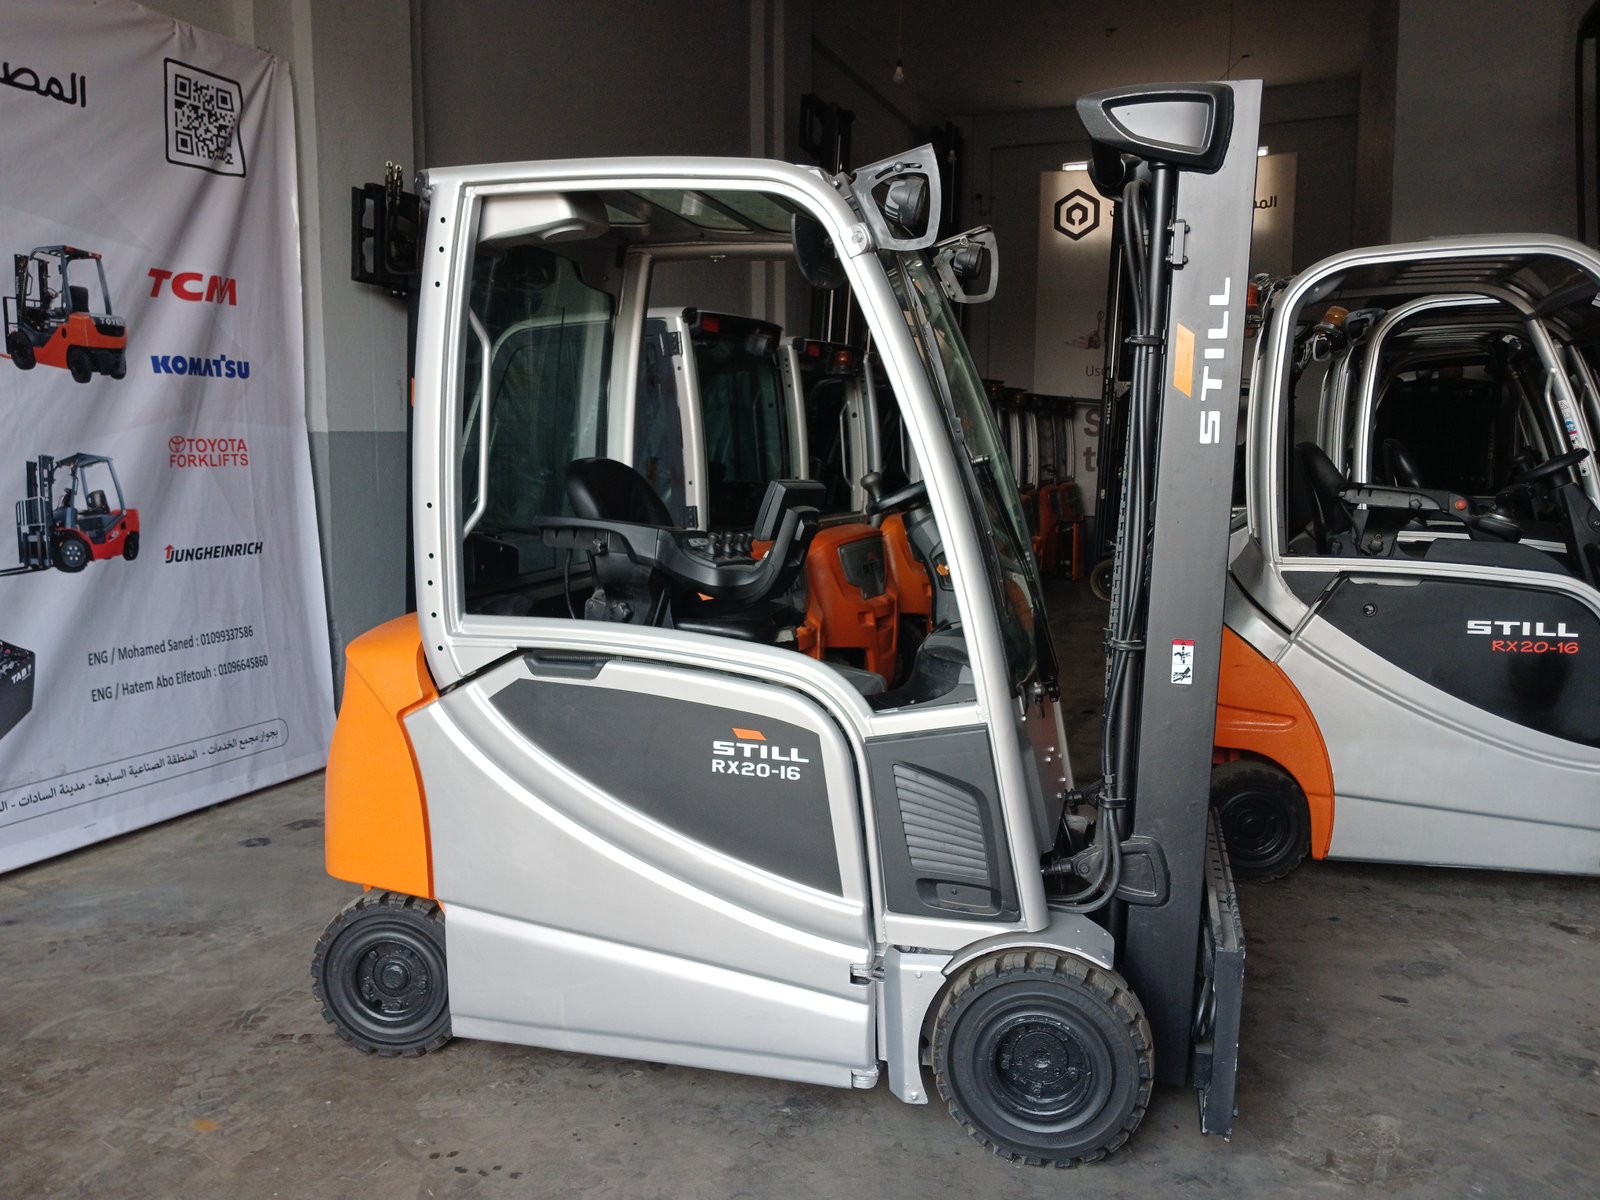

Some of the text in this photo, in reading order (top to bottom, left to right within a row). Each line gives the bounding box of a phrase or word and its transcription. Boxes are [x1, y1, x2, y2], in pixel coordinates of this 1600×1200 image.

[0, 62, 87, 108] المص
[1253, 195, 1278, 209] الم
[148, 267, 237, 306] TCM
[150, 354, 251, 380] KOMATSU
[1199, 277, 1231, 444] STILL
[187, 438, 248, 453] TOYOTA
[169, 453, 249, 468] FORKLIFTS
[165, 541, 263, 564] JUNGHEINRICH
[1466, 619, 1579, 638] STILL
[88, 651, 109, 666] ENG
[111, 647, 115, 665] /
[118, 639, 166, 661] Mohamed
[167, 635, 194, 651] Saned
[200, 625, 253, 646] 01099337586
[1491, 639, 1579, 654] RX20-16
[91, 687, 113, 703] ENG
[115, 682, 119, 701] /
[122, 680, 154, 696] Hatem
[156, 675, 174, 689] Abo
[175, 666, 212, 685] Elfetouh
[218, 654, 268, 676] 01096645860
[239, 736, 259, 750] مجمع
[259, 730, 278, 743] بجوار
[207, 739, 237, 755] الخدمات
[712, 740, 809, 763] STILL
[167, 749, 198, 766] المنطقة
[129, 758, 165, 778] الصناعية
[711, 759, 801, 781] RX20-16
[94, 769, 127, 787] السابعة
[18, 787, 57, 807] السادات
[60, 783, 86, 797] مدينة
[0, 801, 9, 812] ال
